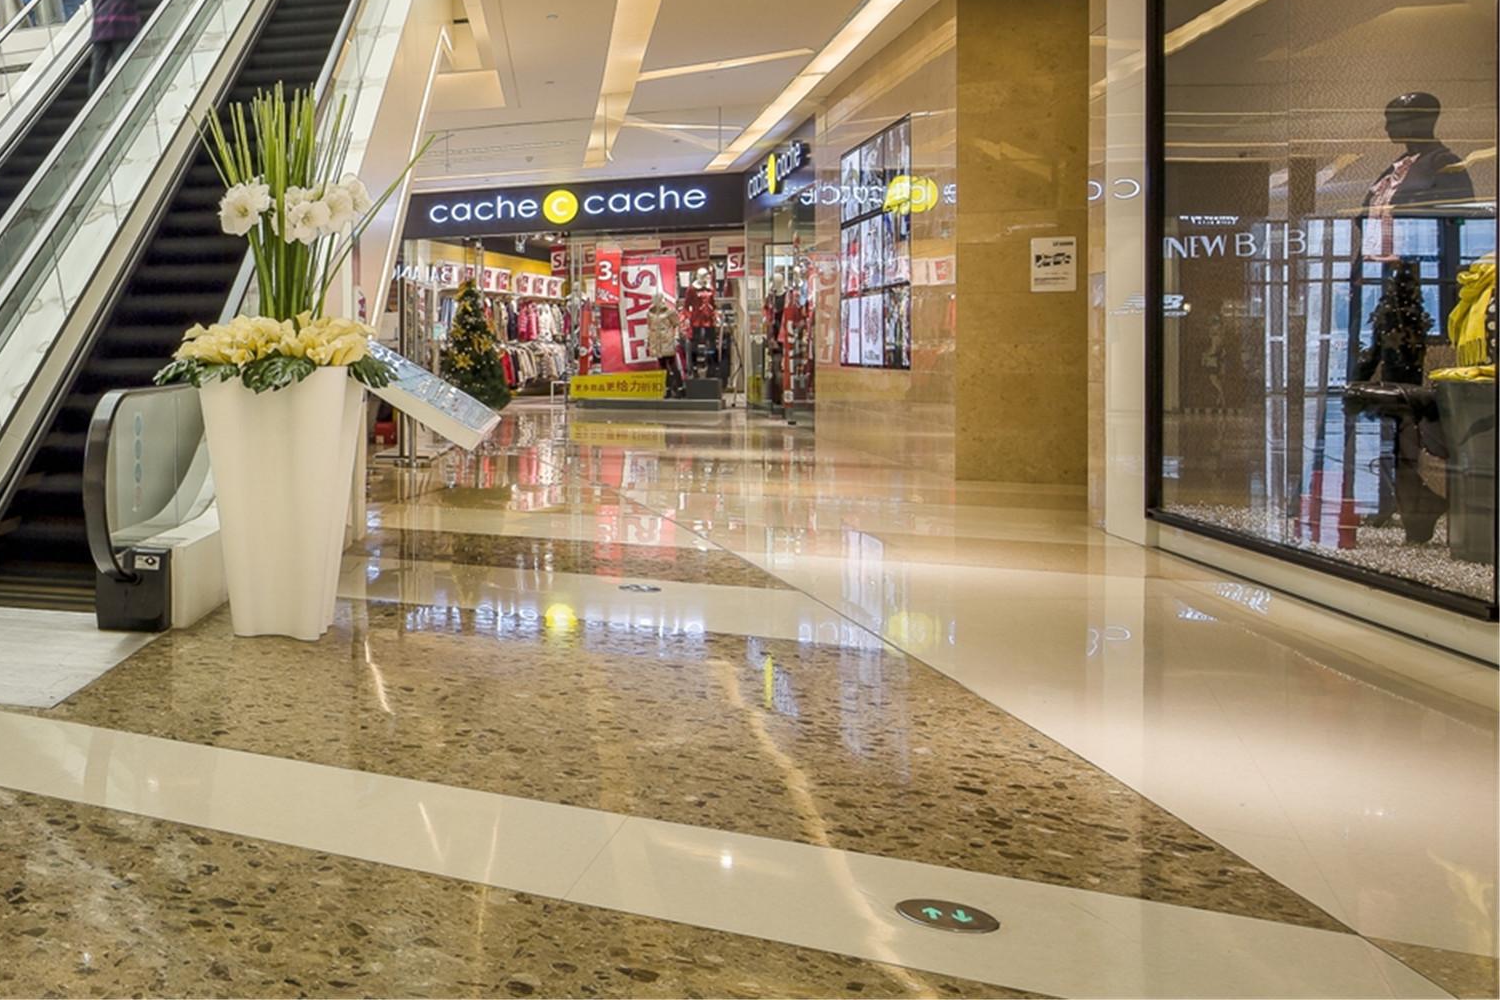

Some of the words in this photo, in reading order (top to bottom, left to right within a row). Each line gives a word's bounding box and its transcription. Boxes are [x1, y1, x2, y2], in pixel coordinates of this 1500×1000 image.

[429, 195, 538, 223] cache
[583, 185, 707, 215] cache
[662, 243, 708, 262] ALE
[620, 269, 658, 361] SALE
